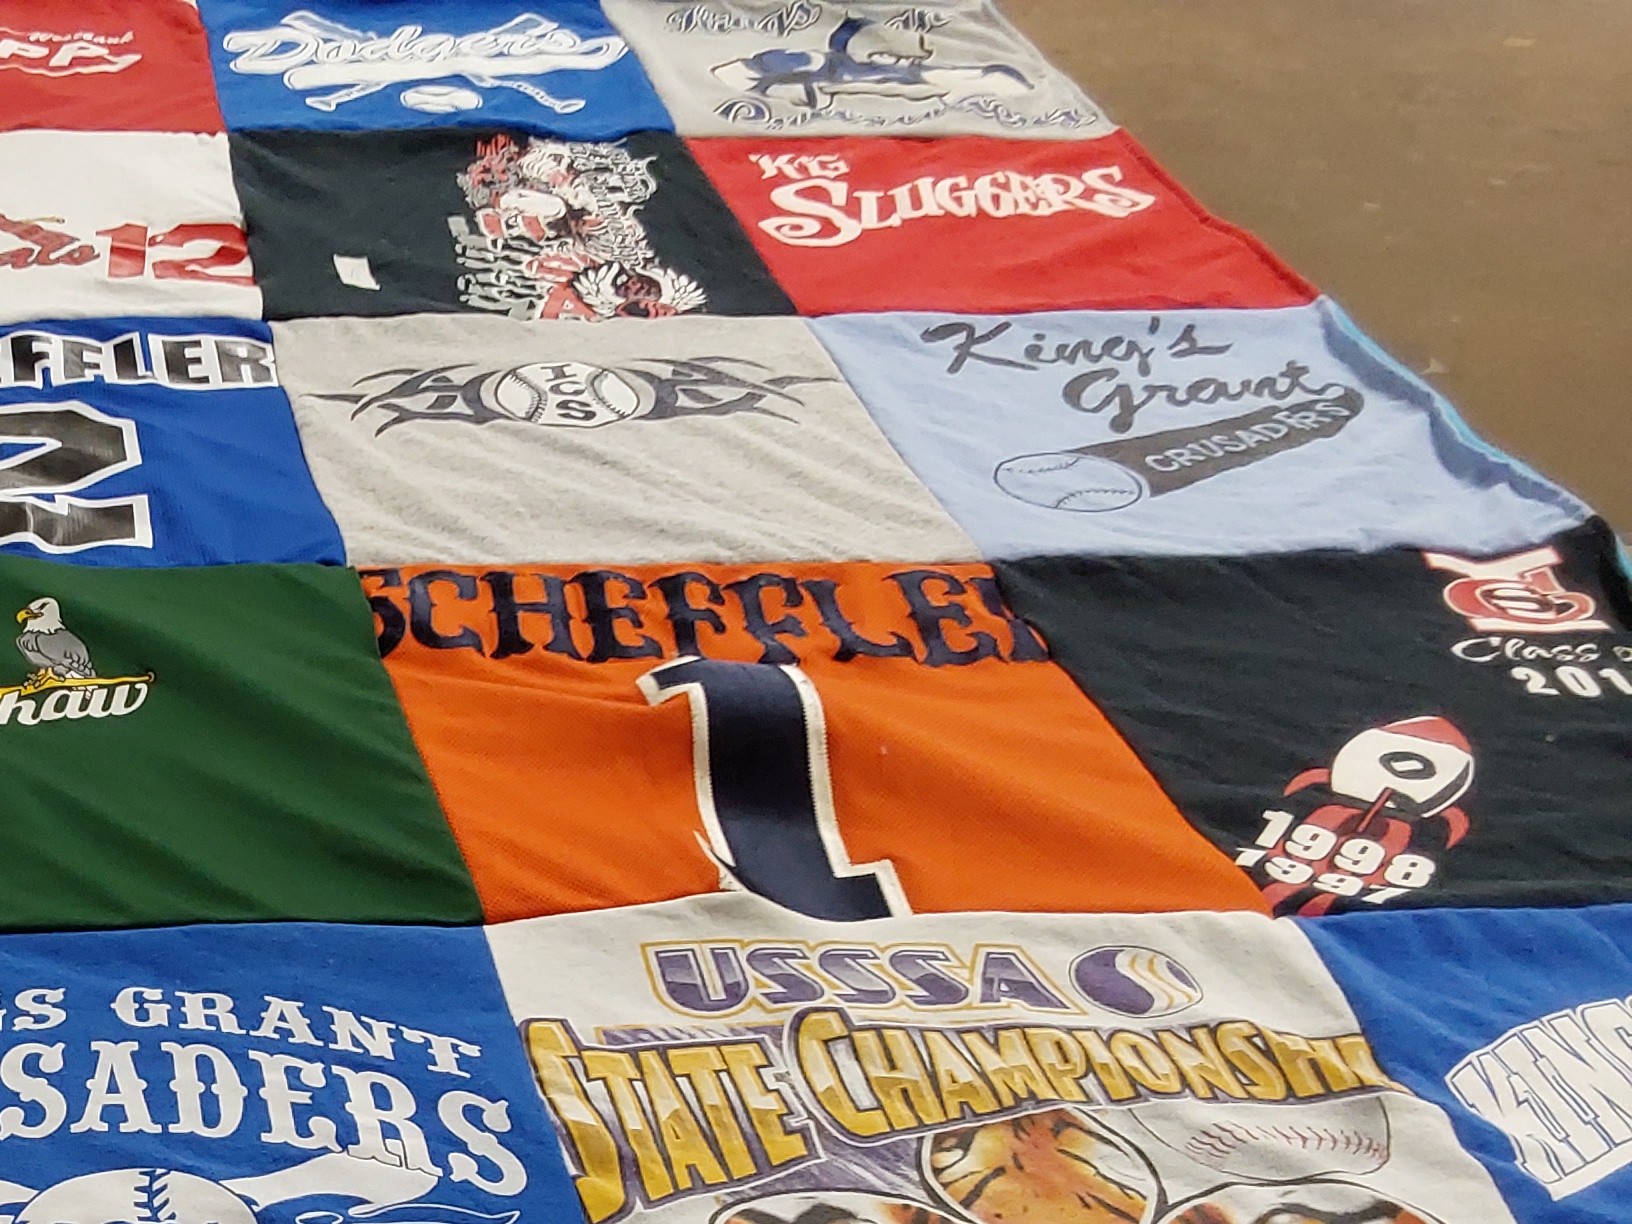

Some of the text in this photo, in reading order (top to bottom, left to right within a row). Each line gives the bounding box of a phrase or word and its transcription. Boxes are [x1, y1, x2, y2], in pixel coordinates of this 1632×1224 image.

[224, 25, 580, 75] Dodgers
[748, 154, 850, 180] KG
[95, 223, 256, 286] 12
[1144, 399, 1352, 476] CRUSADERS
[1450, 636, 1601, 663] Class
[635, 654, 914, 924] 1
[1254, 808, 1438, 888] 1998
[640, 938, 1074, 1018] USSSA
[110, 986, 485, 1079] GRANT
